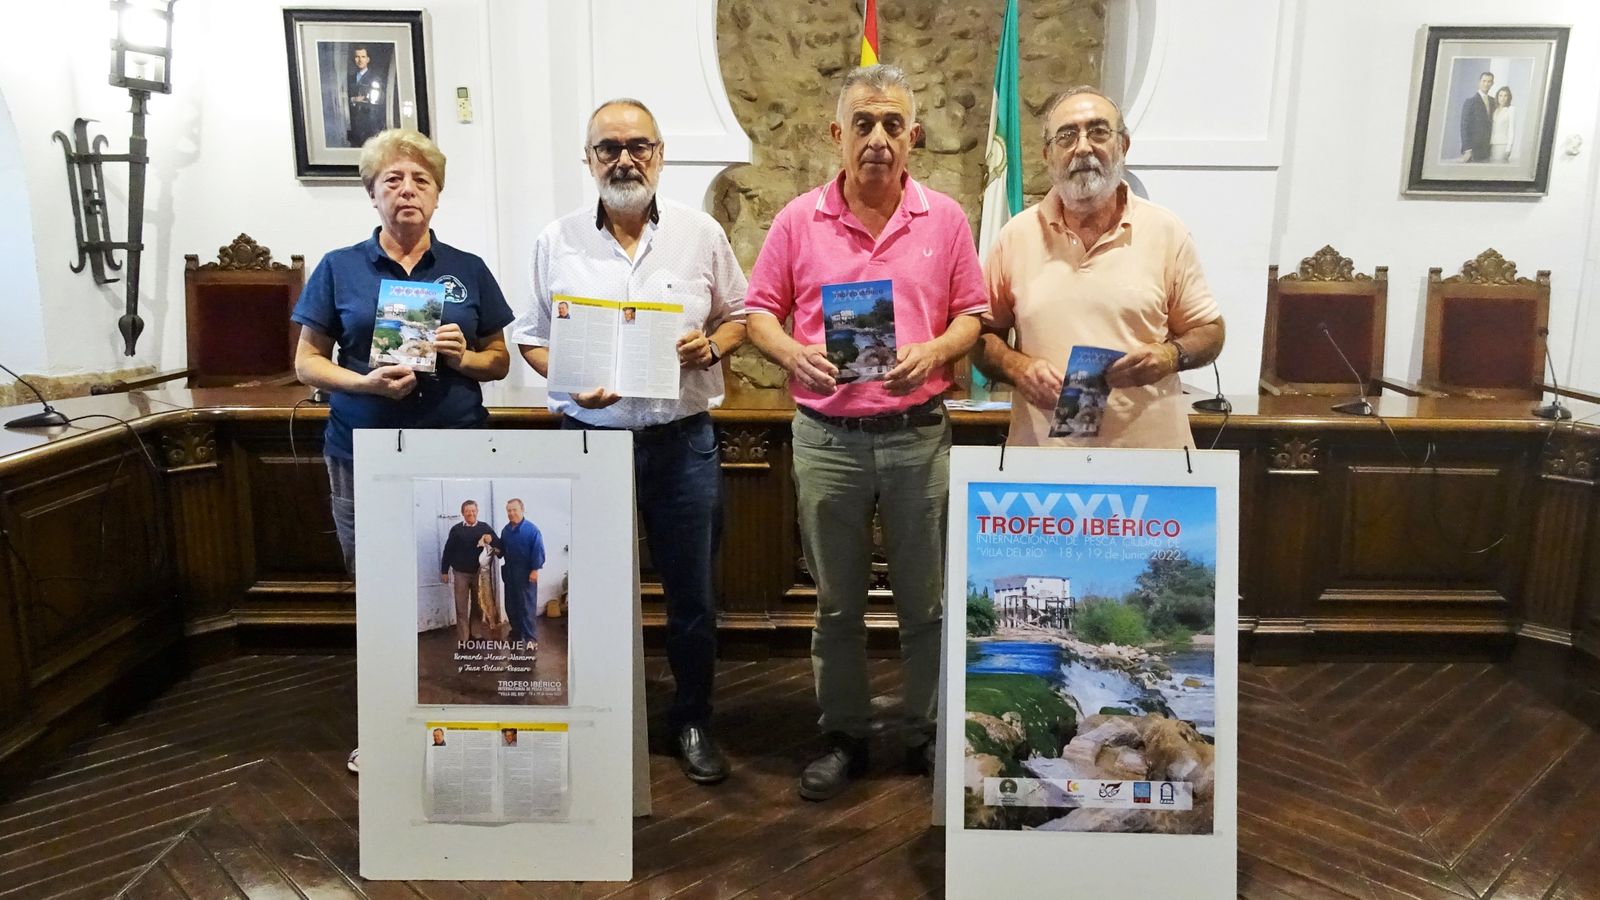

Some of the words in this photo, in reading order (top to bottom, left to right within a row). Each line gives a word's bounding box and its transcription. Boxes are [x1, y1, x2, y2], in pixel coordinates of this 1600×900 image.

[975, 515, 1076, 536] TROFEO
[1082, 514, 1182, 538] IBÉRICO
[976, 534, 1060, 546] INTERNACIONAL
[1065, 536, 1078, 546] DE
[1084, 536, 1118, 547] PESCA
[1122, 537, 1162, 549] CIUDAD
[1167, 538, 1181, 549] DE
[1006, 547, 1023, 558] DEL
[1058, 547, 1073, 559] 18
[1075, 550, 1083, 561] y
[1087, 547, 1102, 559] 19
[1104, 548, 1120, 560] de
[1121, 548, 1148, 561] Junio
[1150, 549, 1181, 561] 2022
[457, 640, 524, 650] HOMENAJE
[526, 640, 539, 651] A:
[453, 652, 483, 661] Bernardo
[507, 653, 537, 661] Navarro
[497, 680, 529, 688] TROFEO
[530, 679, 562, 688] IBÉRICO
